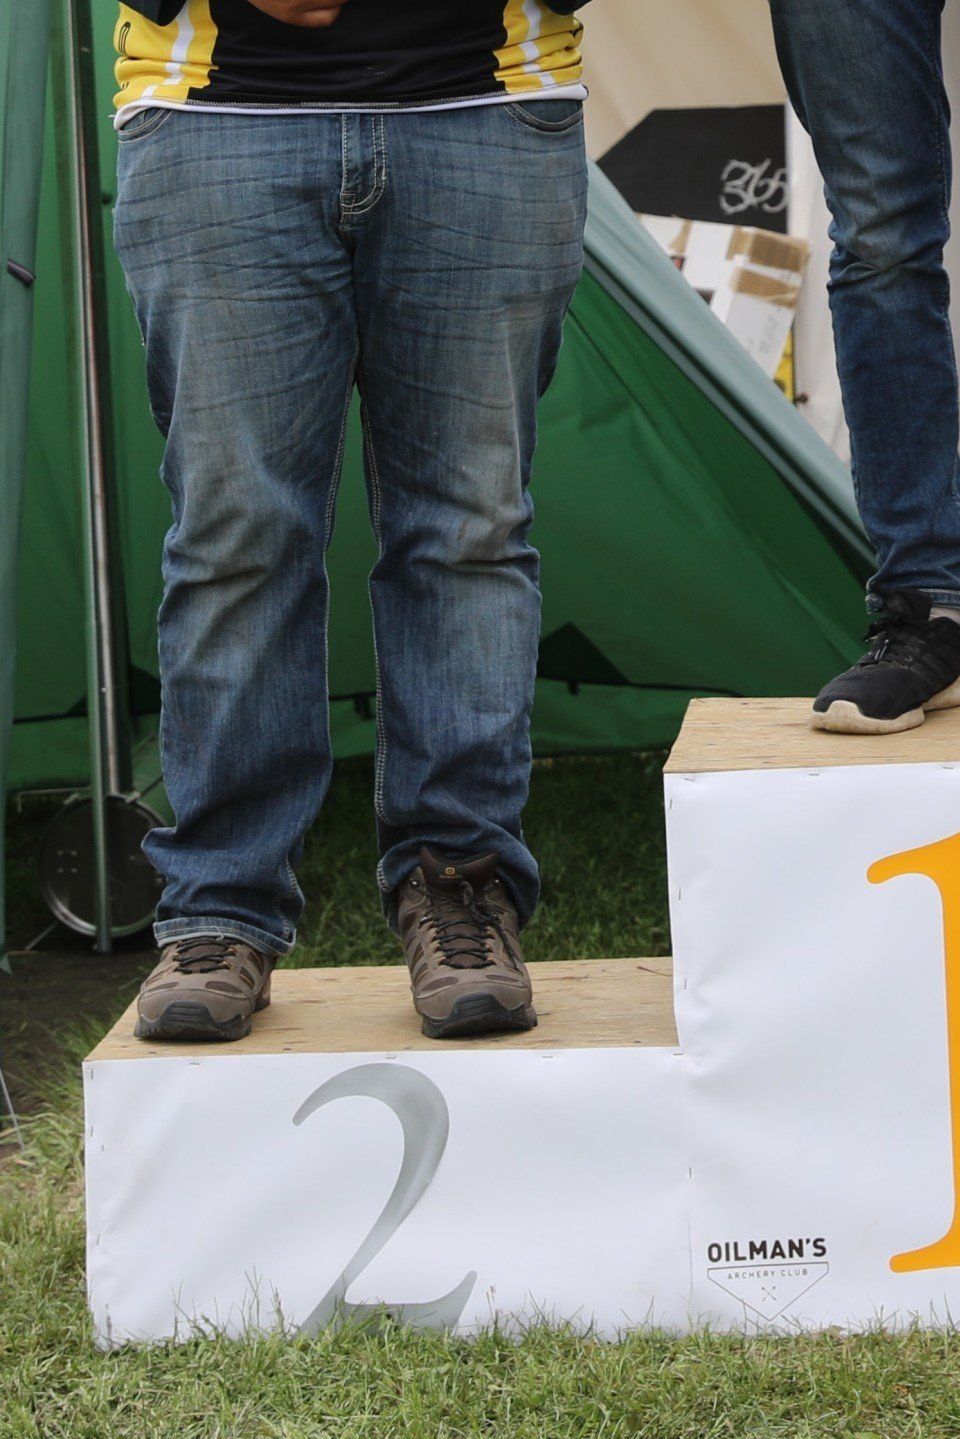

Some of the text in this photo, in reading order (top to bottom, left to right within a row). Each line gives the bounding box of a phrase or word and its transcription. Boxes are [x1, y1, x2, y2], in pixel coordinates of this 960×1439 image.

[292, 1062, 478, 1338] 2
[707, 1238, 827, 1262] OILMAN'S
[727, 1268, 808, 1280] ARCHERY CLUB
